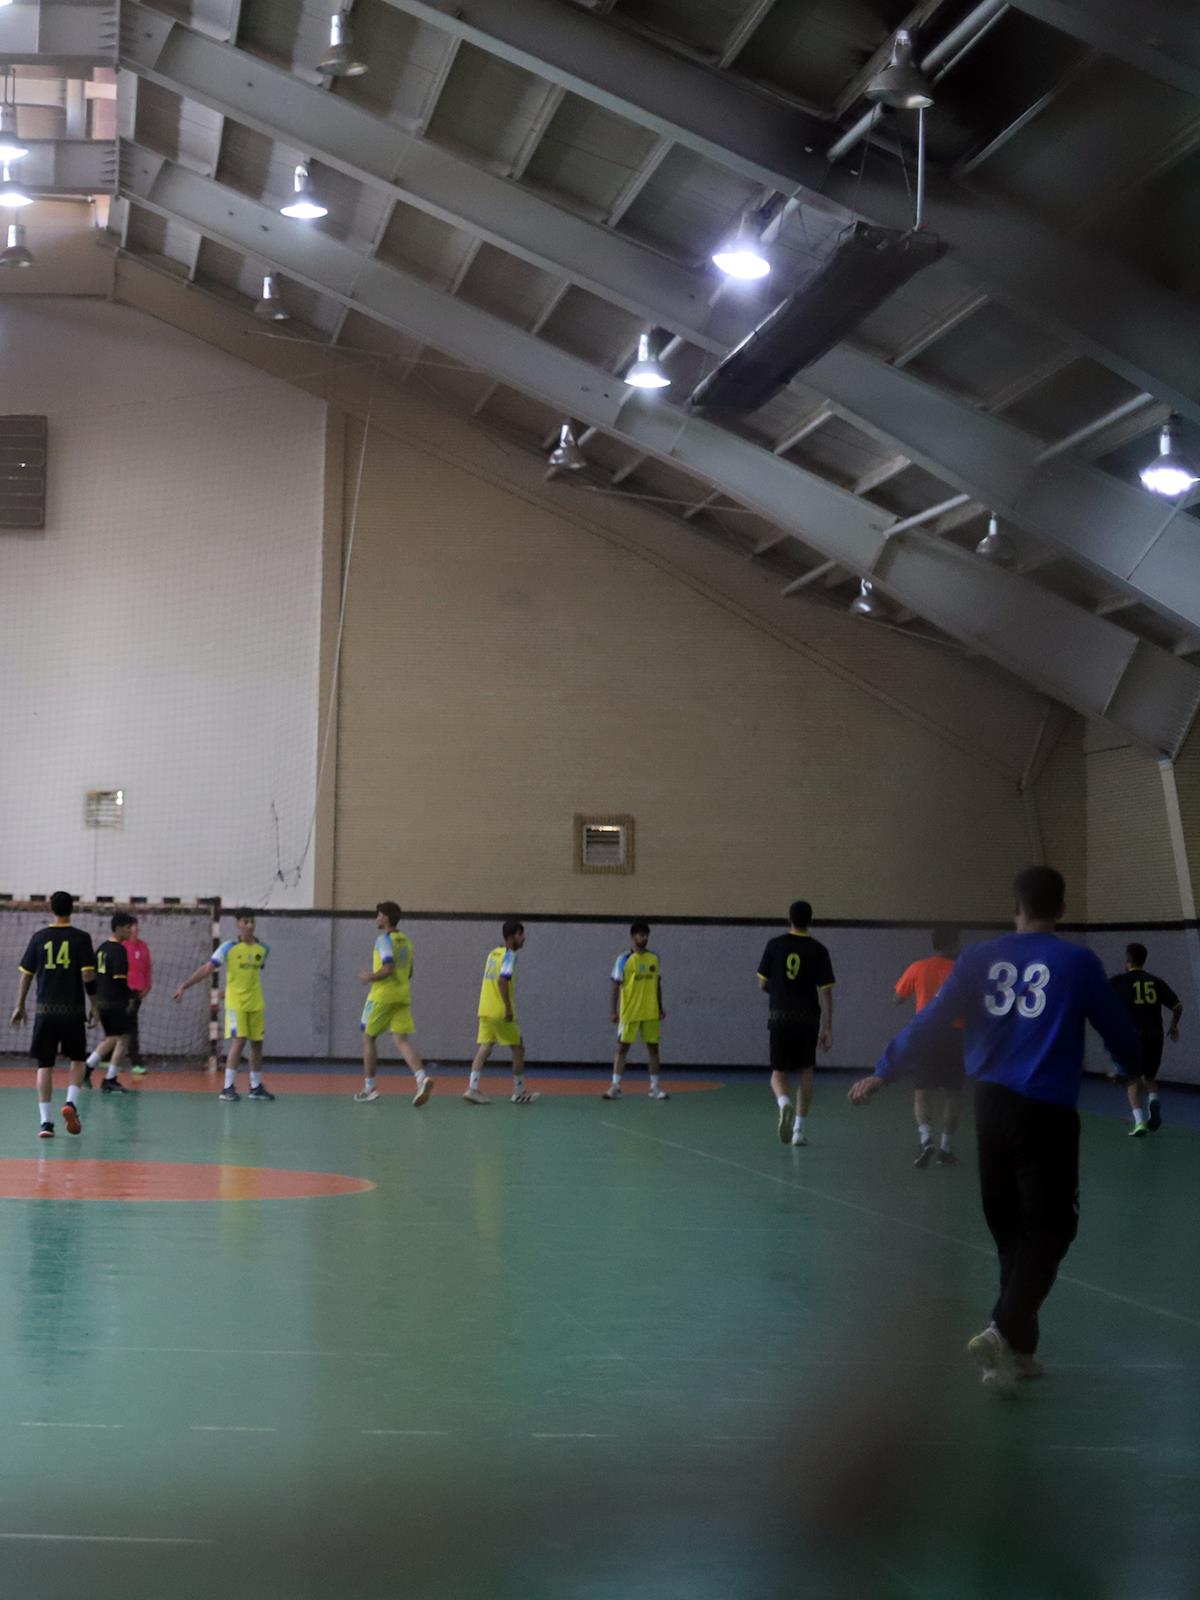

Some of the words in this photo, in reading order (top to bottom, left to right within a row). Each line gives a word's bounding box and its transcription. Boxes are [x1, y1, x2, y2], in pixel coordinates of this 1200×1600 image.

[43, 940, 71, 970] 14
[785, 952, 801, 981] 9
[984, 961, 1051, 1018] 33
[1132, 980, 1158, 1004] 15
